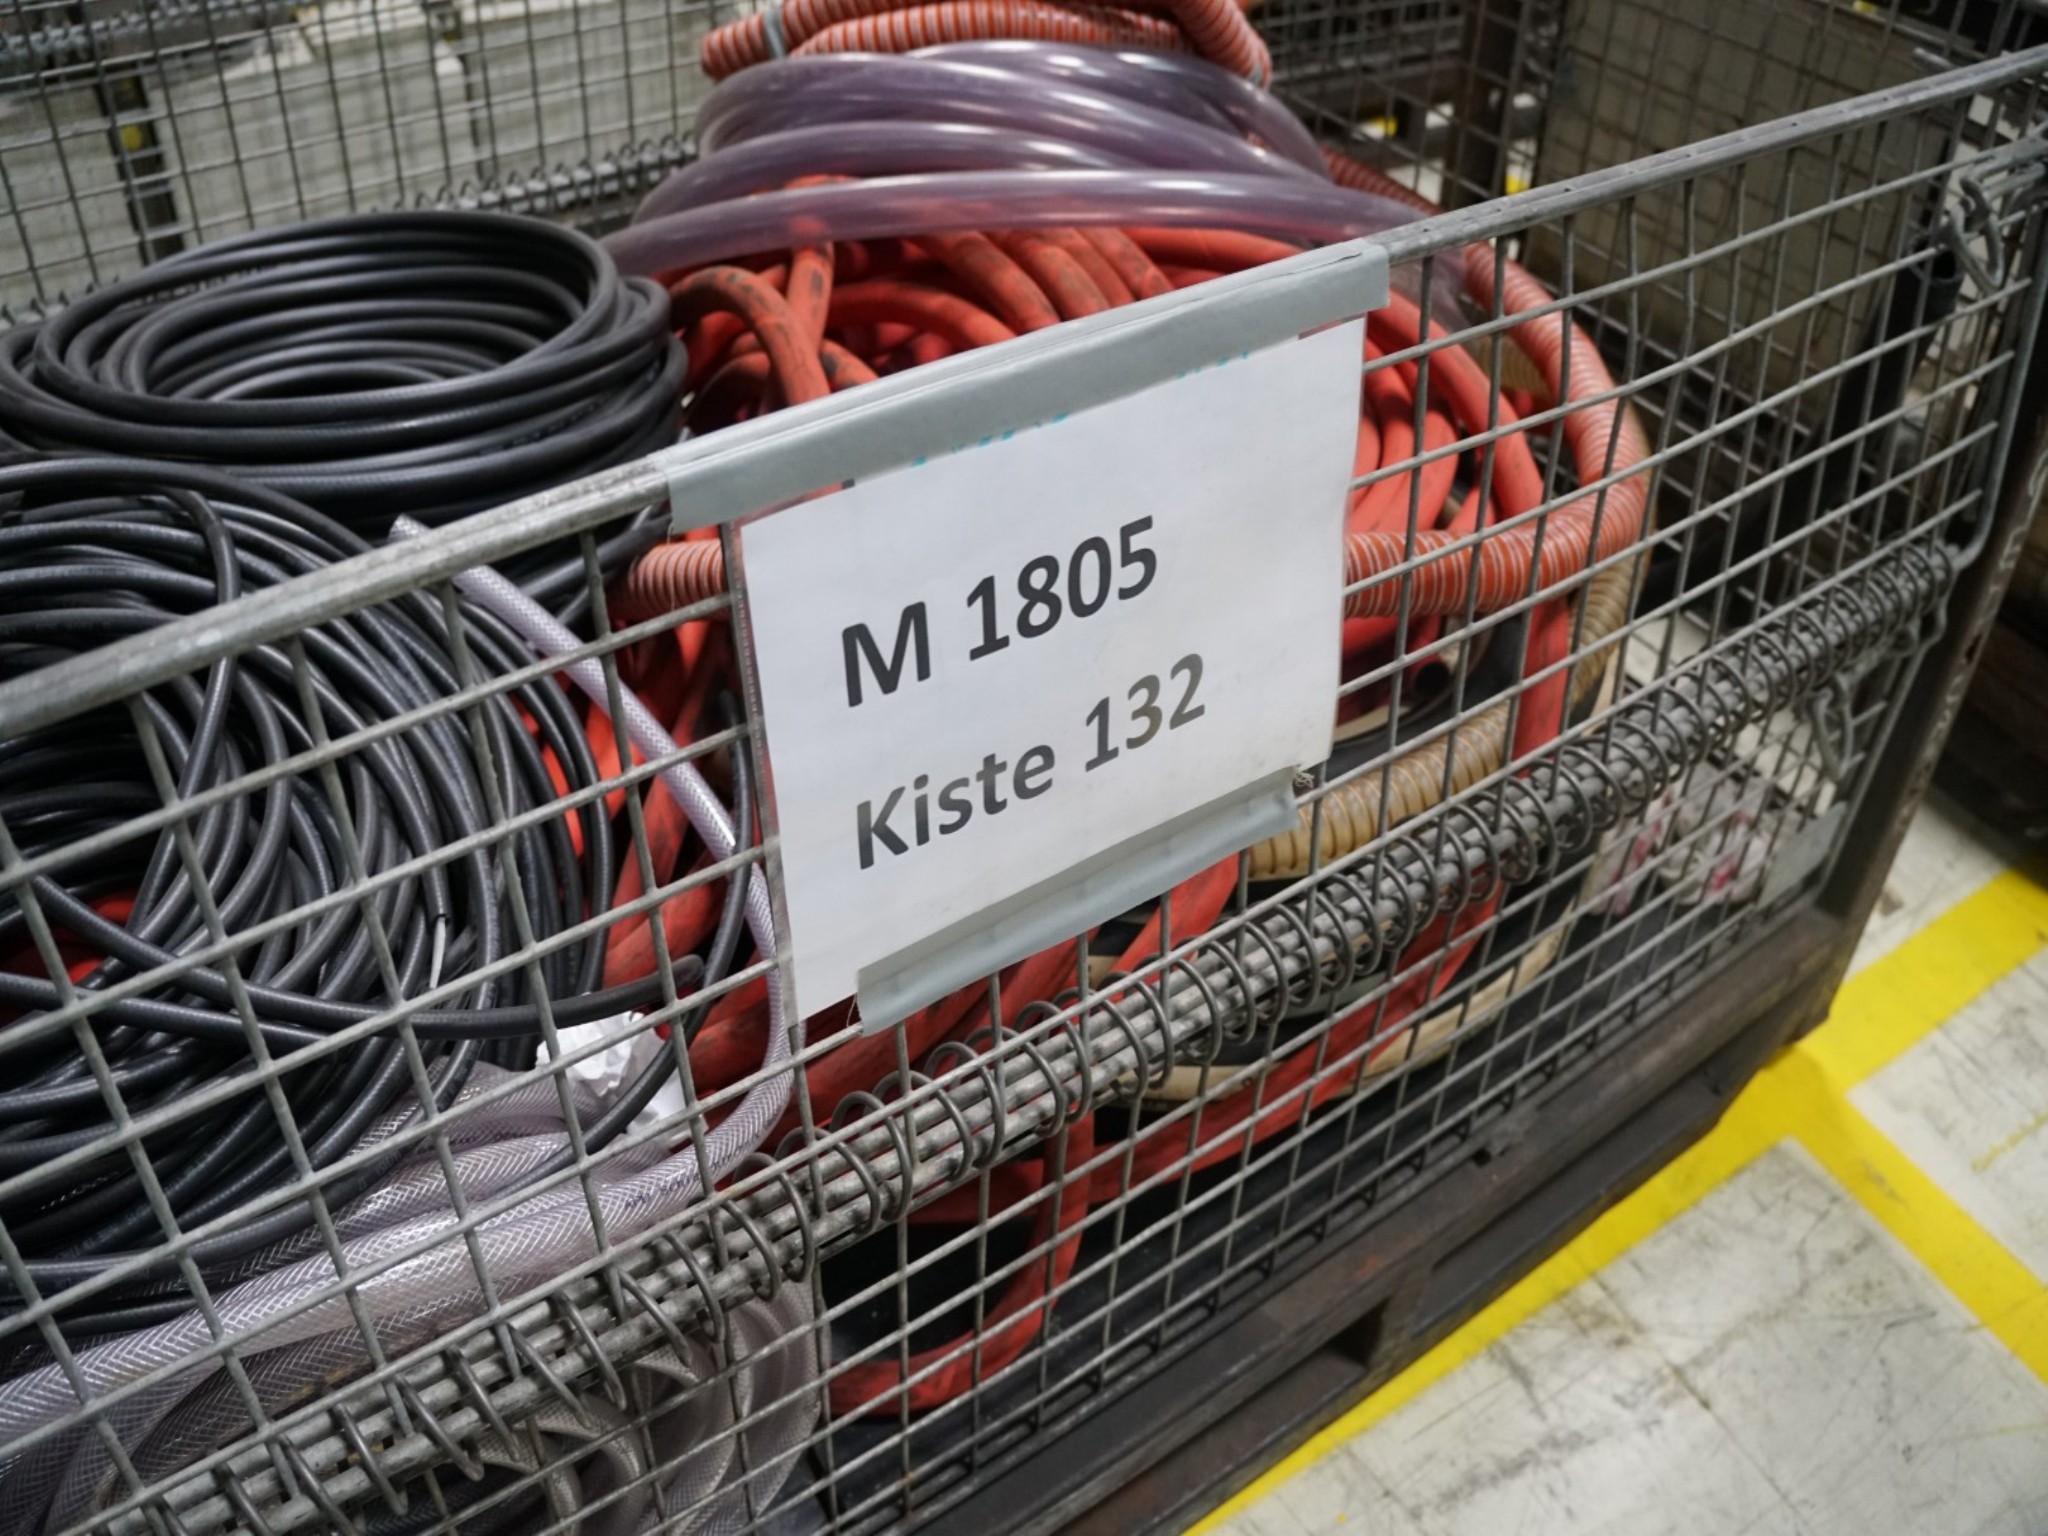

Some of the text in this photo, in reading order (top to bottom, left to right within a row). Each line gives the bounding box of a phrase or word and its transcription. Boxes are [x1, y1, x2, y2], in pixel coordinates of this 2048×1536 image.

[841, 514, 1158, 708] M 1805
[856, 653, 1206, 870] Kiste 132
